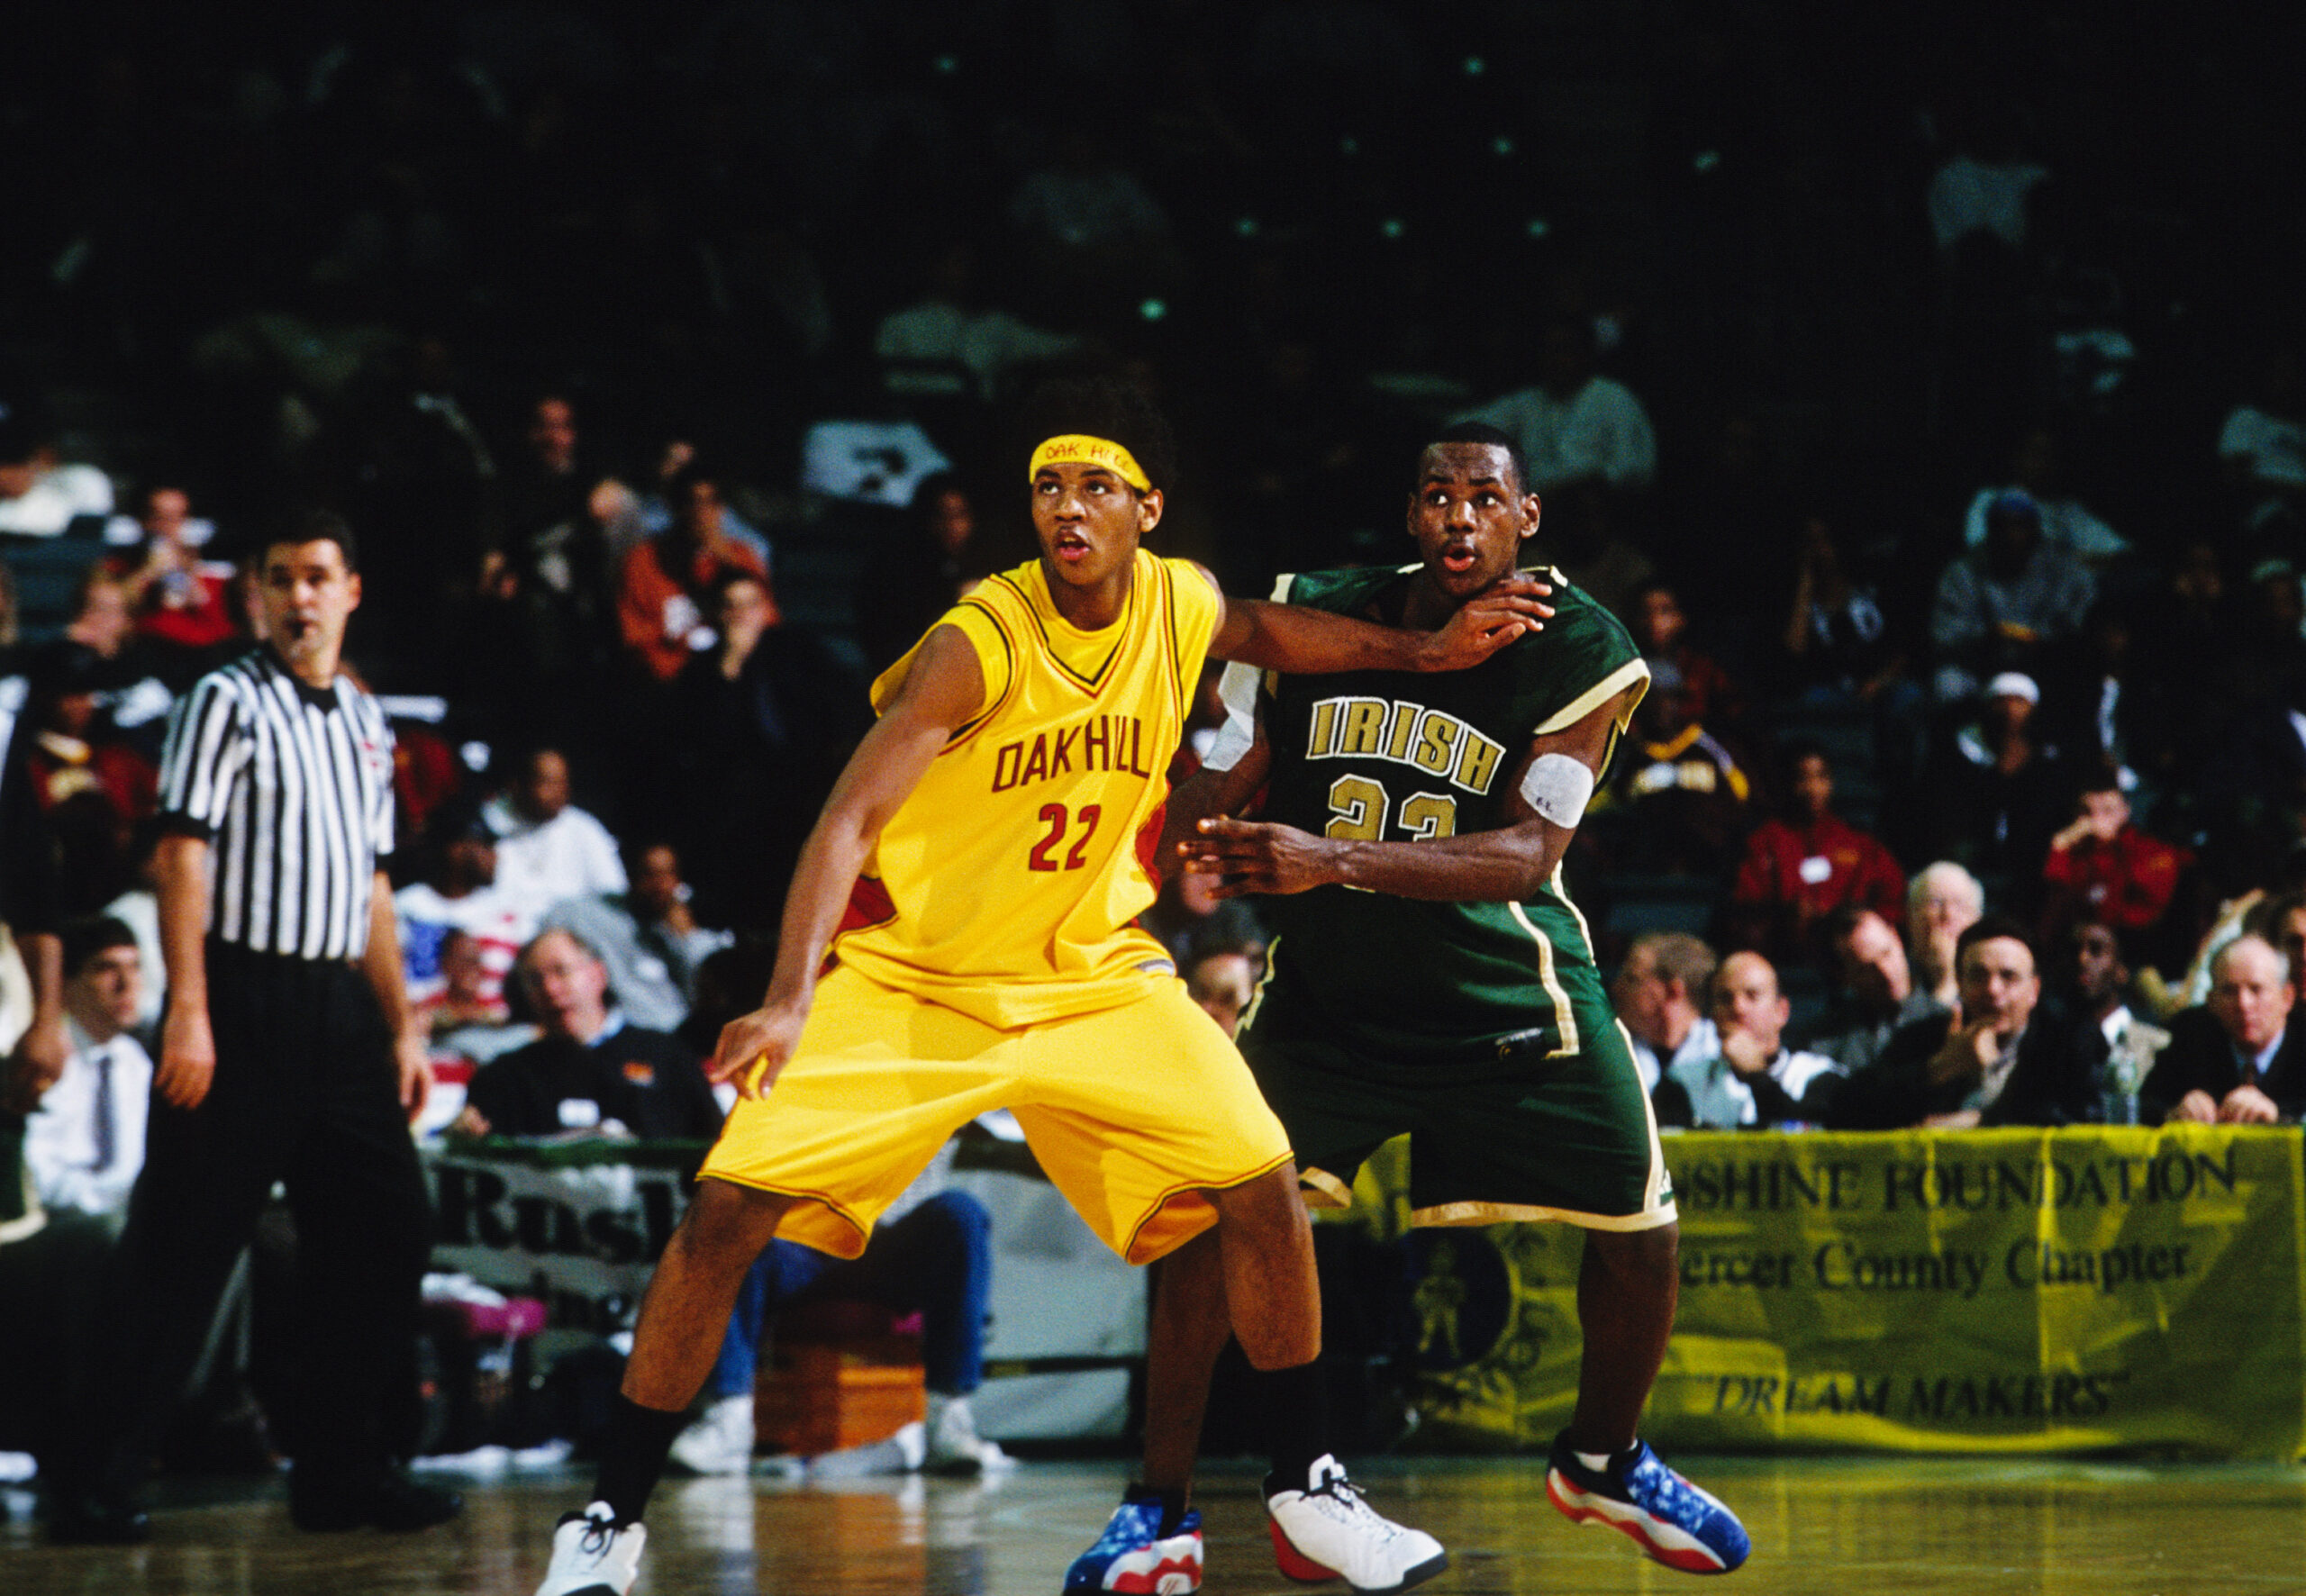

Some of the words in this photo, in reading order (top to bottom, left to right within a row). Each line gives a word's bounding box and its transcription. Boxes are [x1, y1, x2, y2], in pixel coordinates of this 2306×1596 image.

[1045, 443, 1080, 460] OAK
[992, 724, 1081, 793] OAK
[1085, 714, 1150, 780] HILL
[1305, 695, 1507, 796] IRISH
[1028, 803, 1102, 872] 22
[1884, 1138, 2237, 1212] FOUNDATION
[1680, 1249, 1795, 1290] ercer
[1812, 1242, 1987, 1299] County
[2005, 1235, 2189, 1294] Chapter
